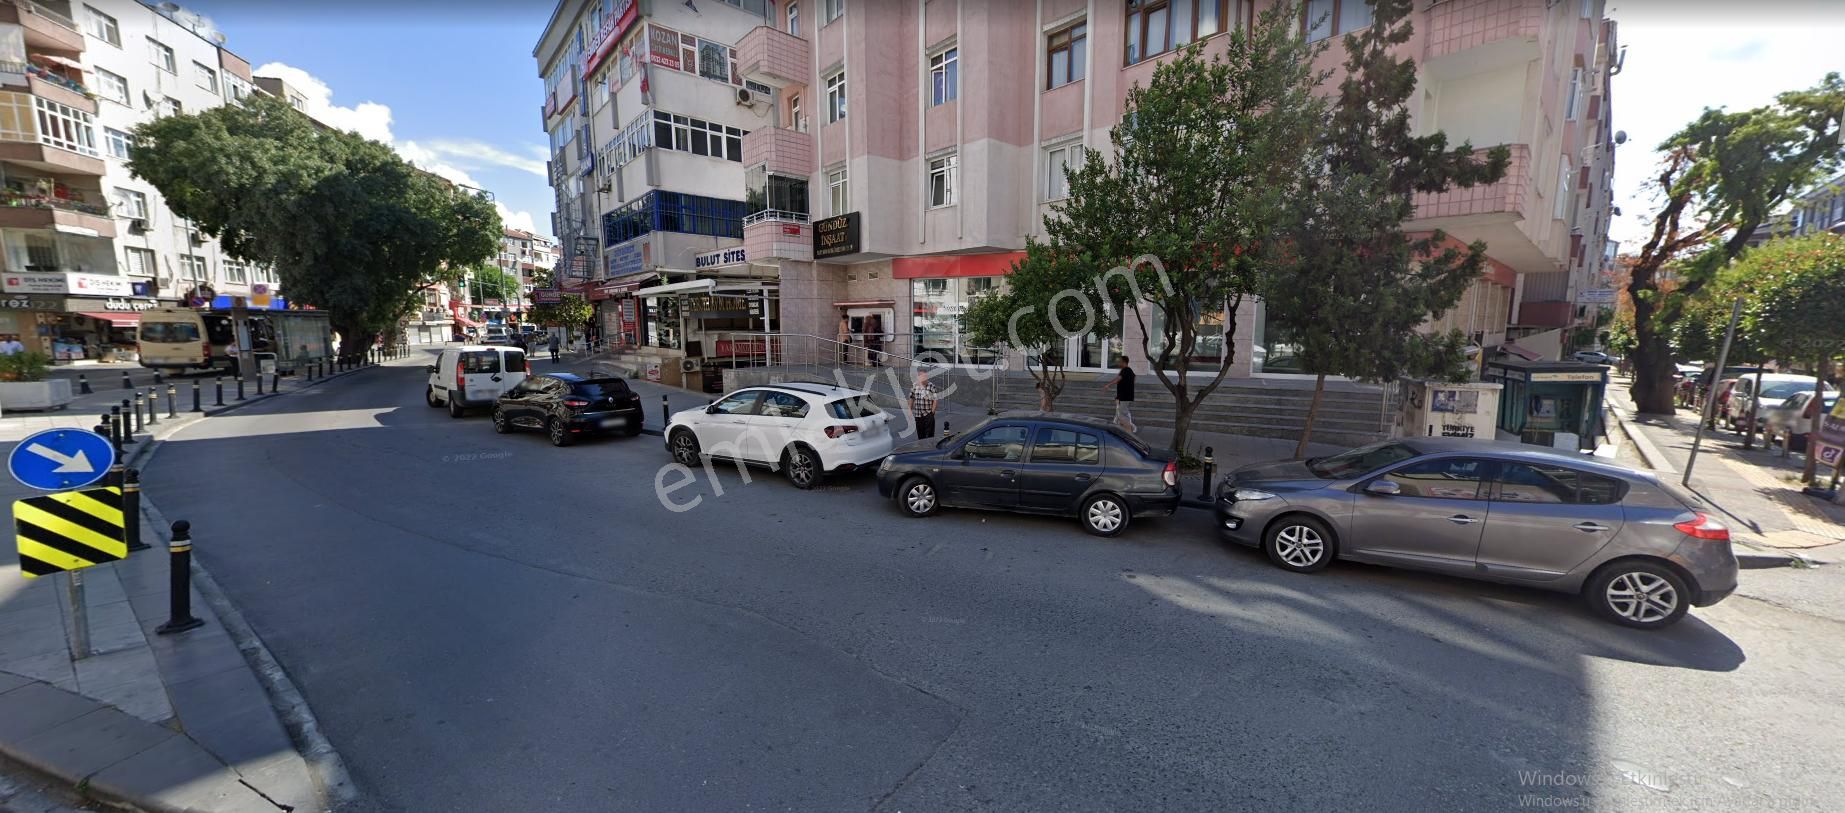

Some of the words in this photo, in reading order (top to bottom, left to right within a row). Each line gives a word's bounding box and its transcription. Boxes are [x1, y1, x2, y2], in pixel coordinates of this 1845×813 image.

[650, 27, 678, 48] KOZAN
[818, 216, 848, 232] GÜNDÜZ
[821, 231, 846, 246] İNŞAAT
[695, 255, 721, 267] BULUT
[105, 297, 131, 310] dudu
[1441, 423, 1476, 433] TÜRKİYE
